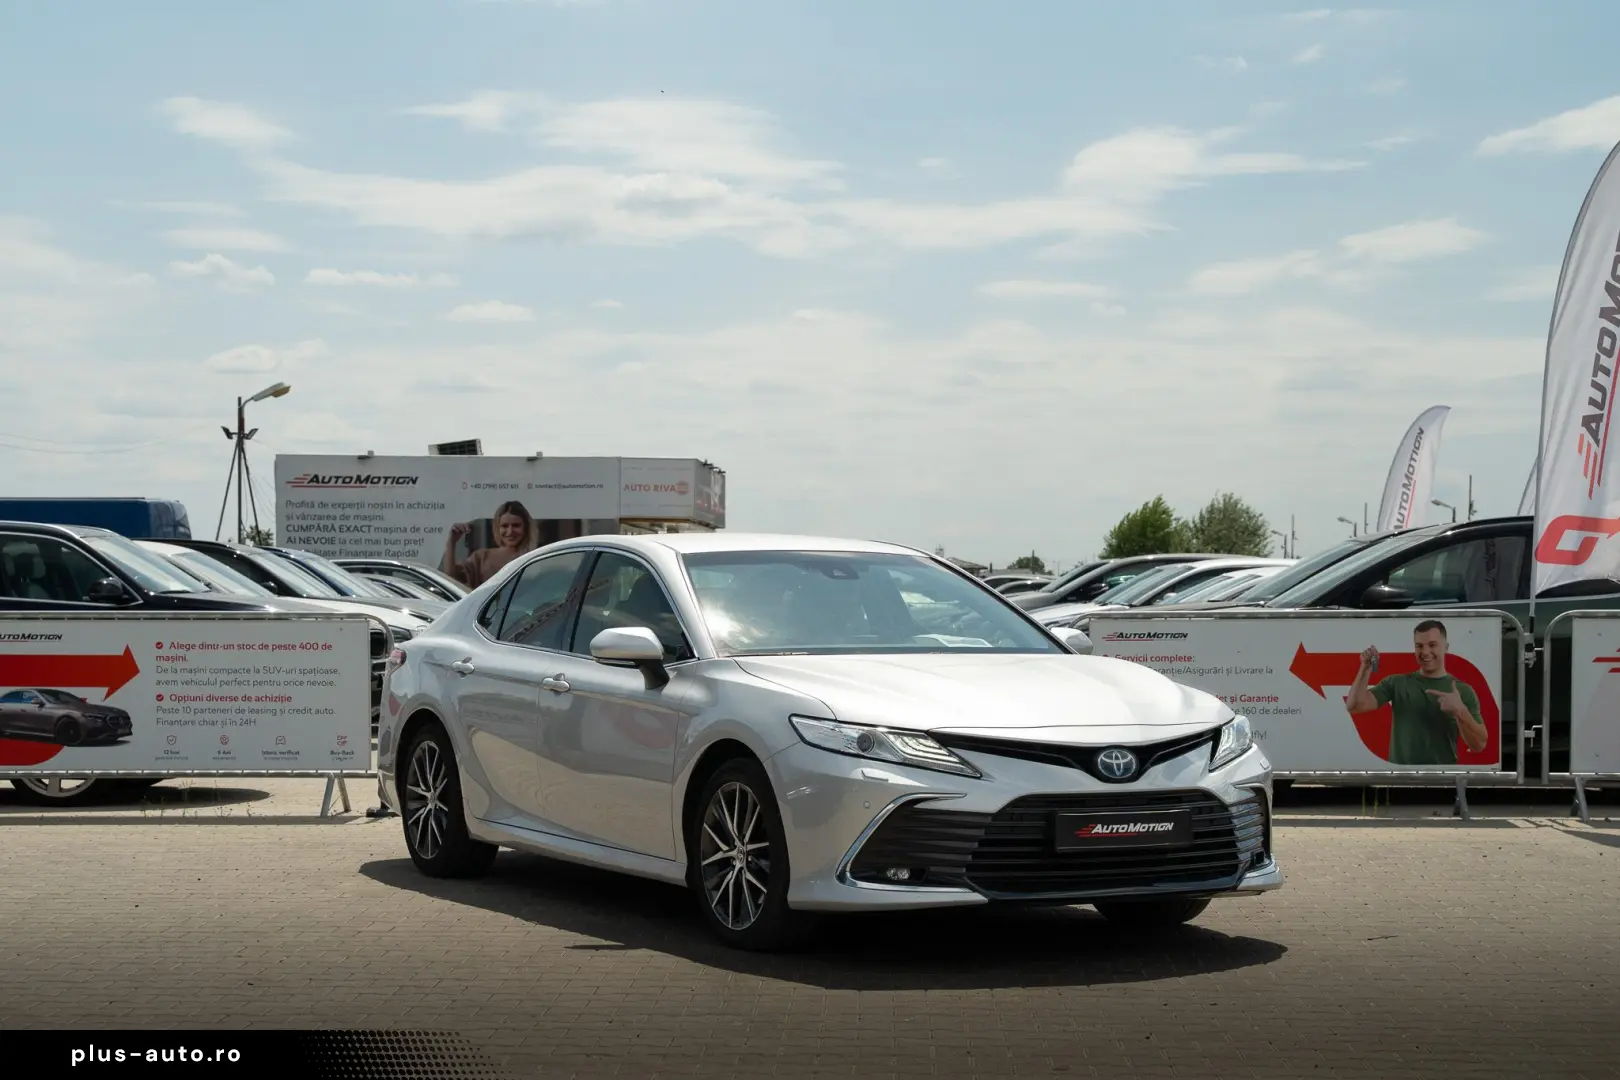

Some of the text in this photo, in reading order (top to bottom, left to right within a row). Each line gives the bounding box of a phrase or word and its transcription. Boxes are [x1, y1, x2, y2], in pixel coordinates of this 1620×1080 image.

[307, 474, 419, 485] AUTOMOTION
[623, 484, 651, 492] AUTO
[317, 500, 330, 509] de
[331, 500, 365, 511] experții
[296, 513, 337, 521] vânzarea
[339, 513, 351, 521] de
[338, 524, 372, 533] EXACT
[374, 525, 407, 534] mașina
[410, 525, 420, 533] de
[286, 536, 297, 544] AI
[298, 536, 336, 544] NEVOIE
[338, 536, 346, 544] la
[349, 536, 362, 545] cel
[364, 537, 382, 545] mai
[384, 537, 401, 545] bun
[339, 549, 382, 558] Finanțare
[1116, 631, 1188, 639] AUTOMOTION
[169, 641, 332, 652] Alege dintr-un stoc de peste 400 de
[156, 654, 188, 664] mașini.
[1150, 654, 1195, 664] complete:
[156, 666, 168, 674] De
[171, 666, 178, 674] la
[180, 666, 206, 676] mașini
[208, 666, 251, 676] compacte
[254, 666, 260, 674] la
[262, 666, 296, 674] SUV-uri
[1148, 666, 1273, 677] aranție/Asigurări și Livrare la
[180, 678, 218, 686] vehiculul
[220, 678, 250, 688] perfect
[252, 678, 281, 688] pentru
[283, 678, 304, 686] orice
[306, 678, 336, 686] nevoie.
[170, 694, 292, 704] Opțiuni diverse de achiziție
[1230, 694, 1238, 704] și
[1240, 694, 1279, 704] Garanție
[156, 706, 180, 714] Peste
[182, 706, 192, 714] 10
[194, 706, 232, 716] parteneri
[234, 706, 245, 714] de
[247, 706, 277, 716] leasing
[280, 706, 286, 716] și
[287, 706, 312, 714] credit
[1242, 706, 1256, 715] 160
[1259, 706, 1269, 714] de
[1272, 706, 1302, 714] dealeri
[156, 718, 196, 728] Finanțare
[198, 718, 218, 726] chiar
[221, 718, 228, 728] și
[1092, 822, 1174, 834] AUTOMOTION
